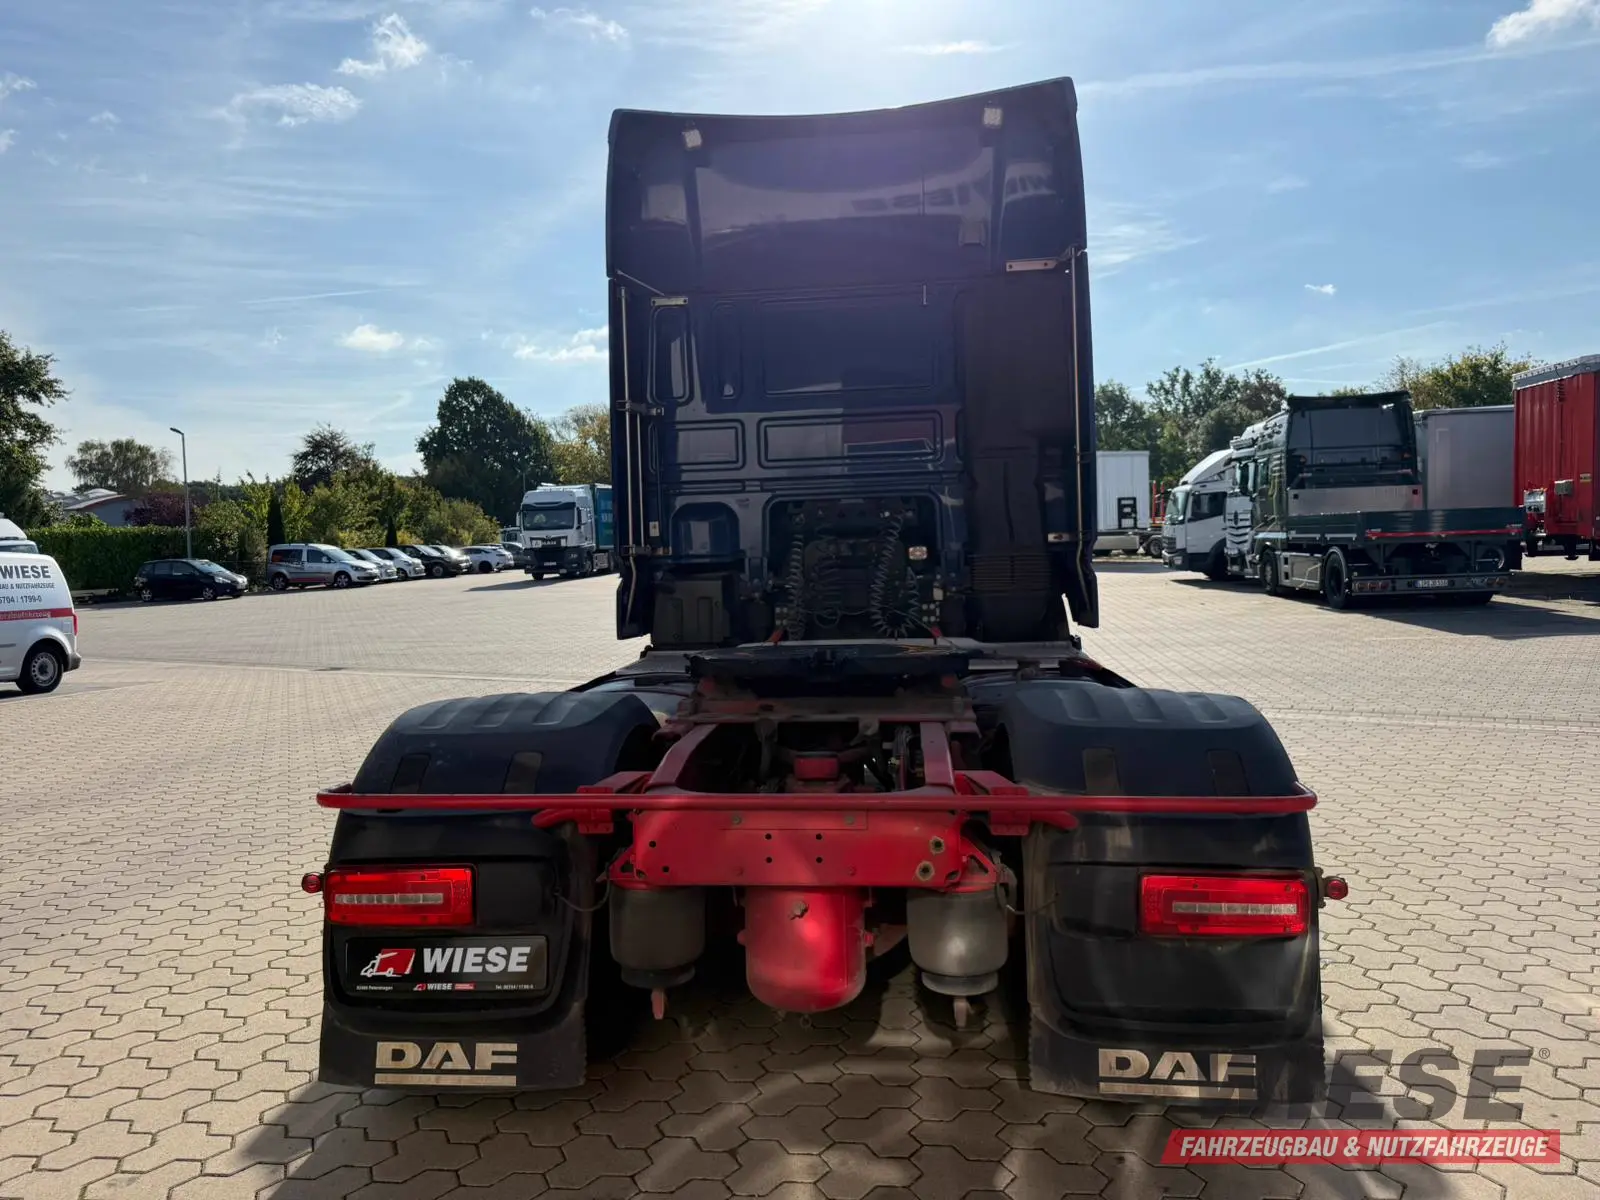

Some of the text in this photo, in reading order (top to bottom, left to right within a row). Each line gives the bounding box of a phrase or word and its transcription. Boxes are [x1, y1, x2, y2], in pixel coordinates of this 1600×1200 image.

[0, 565, 51, 579] WIESE
[423, 946, 531, 974] WIESE
[427, 983, 453, 991] WIESE
[376, 1041, 518, 1070] DAF
[1098, 1047, 1257, 1082] DAF
